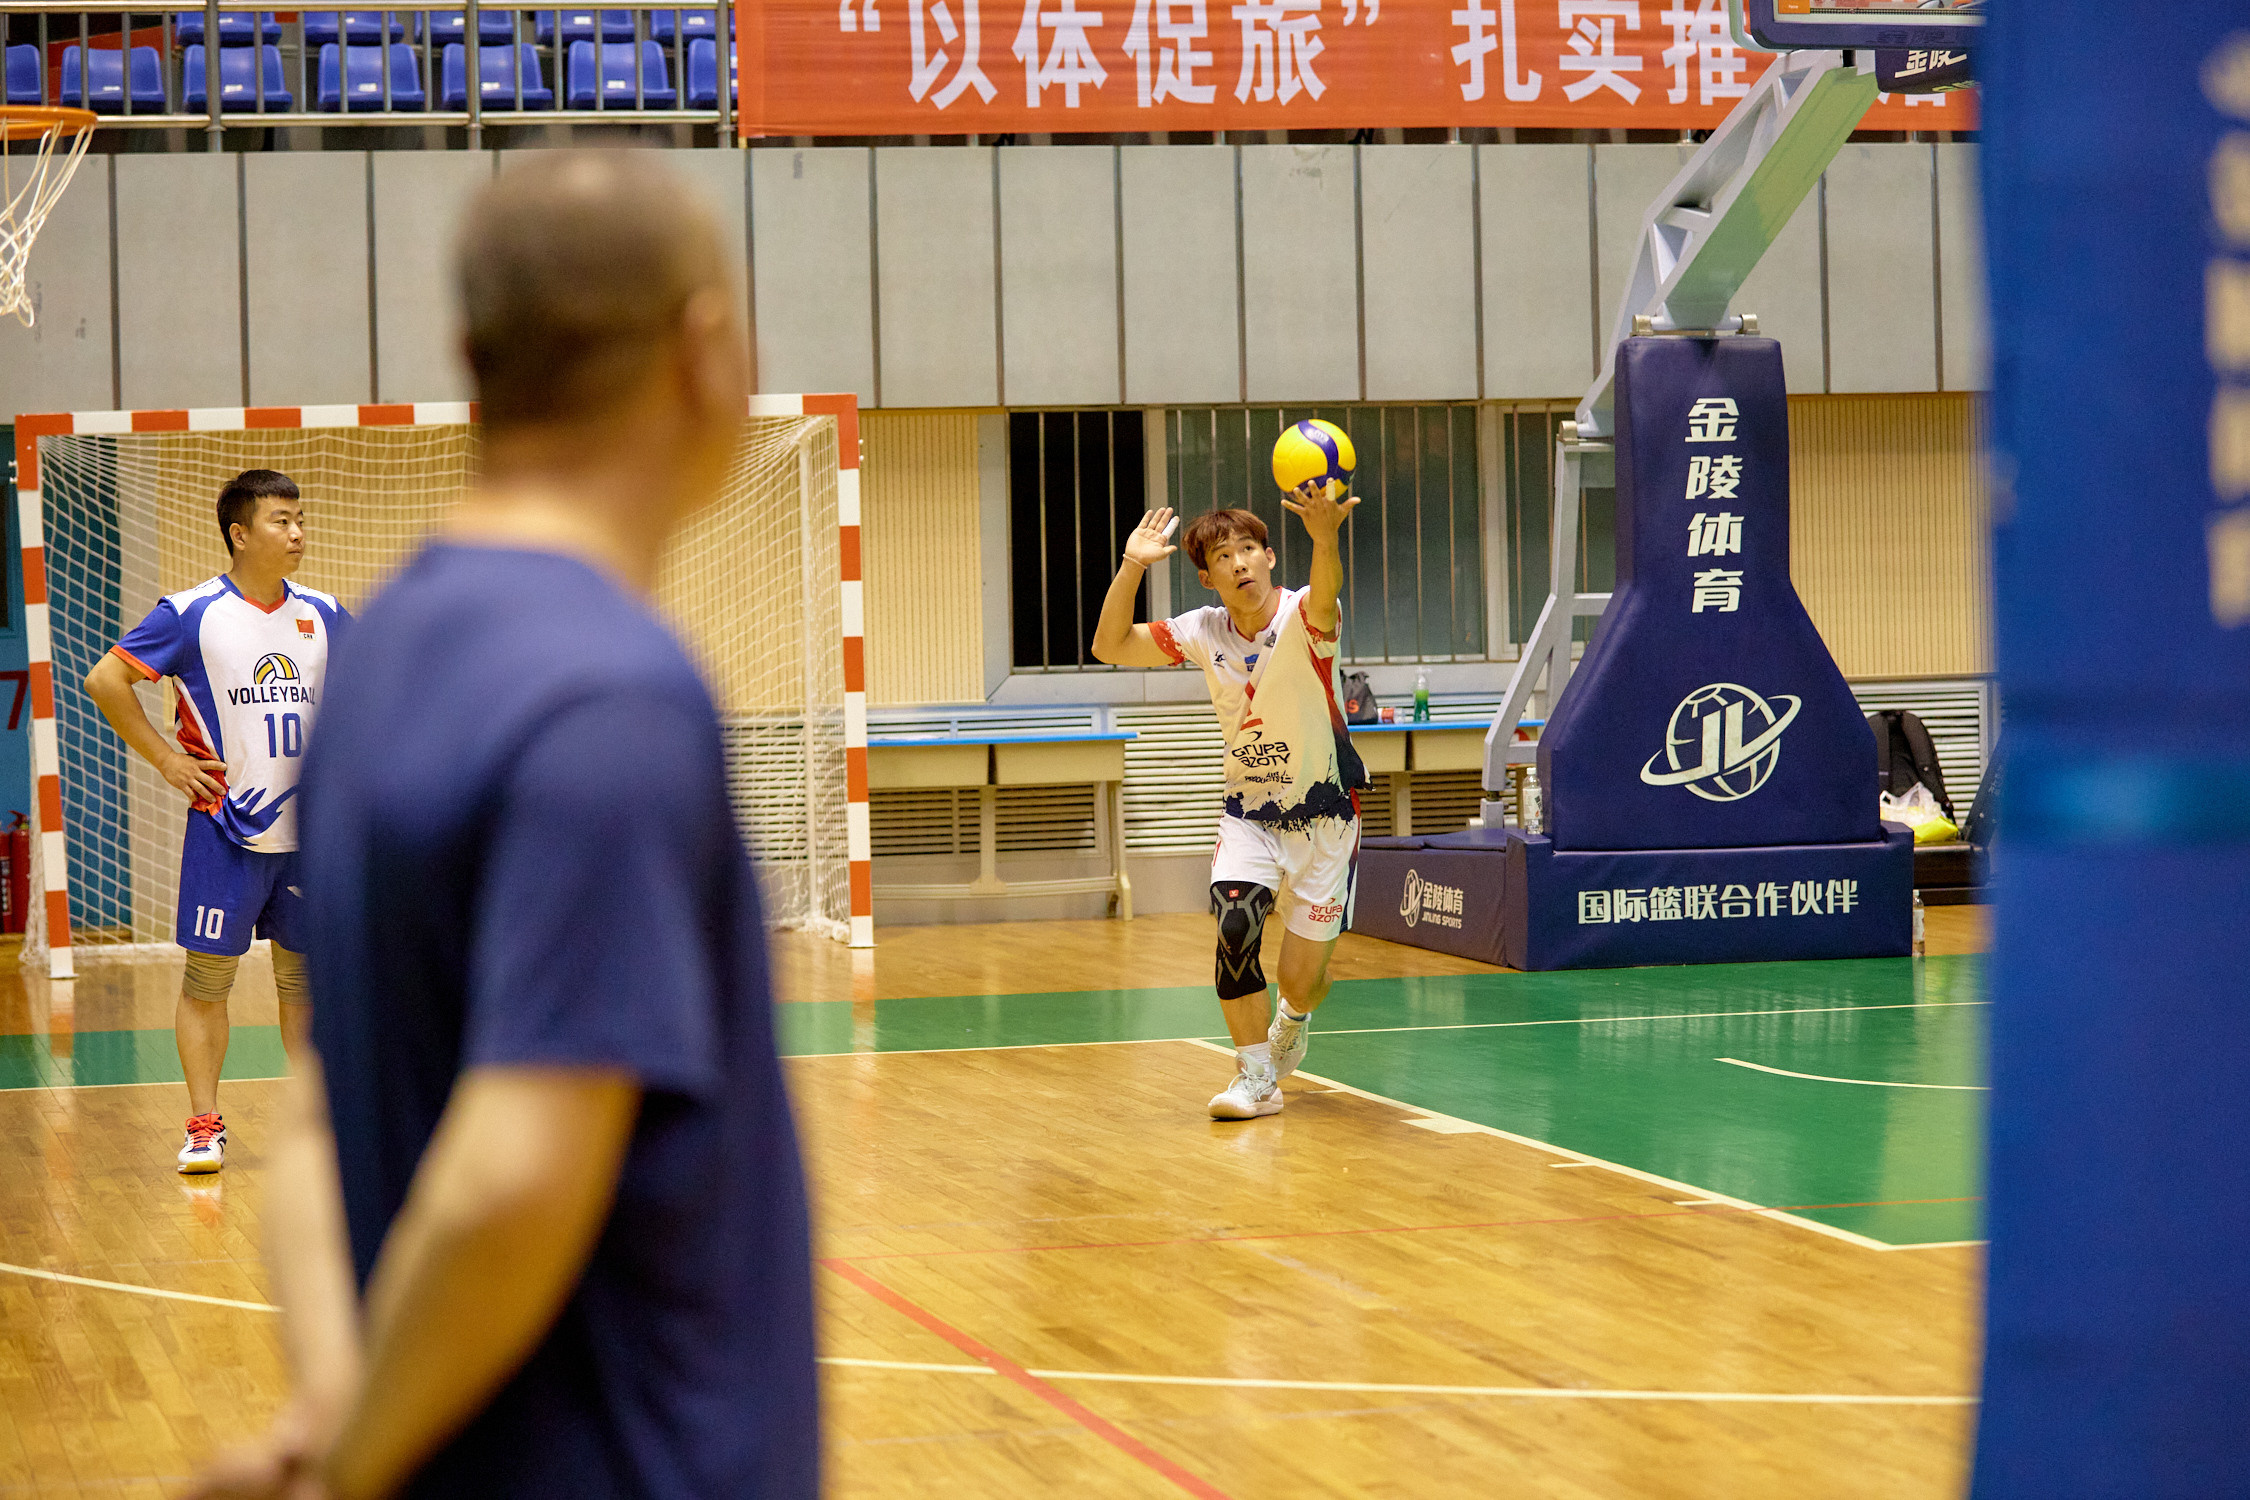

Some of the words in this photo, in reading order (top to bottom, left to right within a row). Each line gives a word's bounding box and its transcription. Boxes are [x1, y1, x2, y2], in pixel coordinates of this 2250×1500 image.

[1684, 397, 1745, 614] 金陵体育
[263, 712, 302, 758] 10
[1423, 882, 1464, 915] 金陵体育
[1577, 878, 1860, 925] 国际篮联合作伙伴
[194, 905, 225, 940] 10
[1422, 911, 1441, 925] JINLING
[1441, 915, 1462, 929] SPORTS
